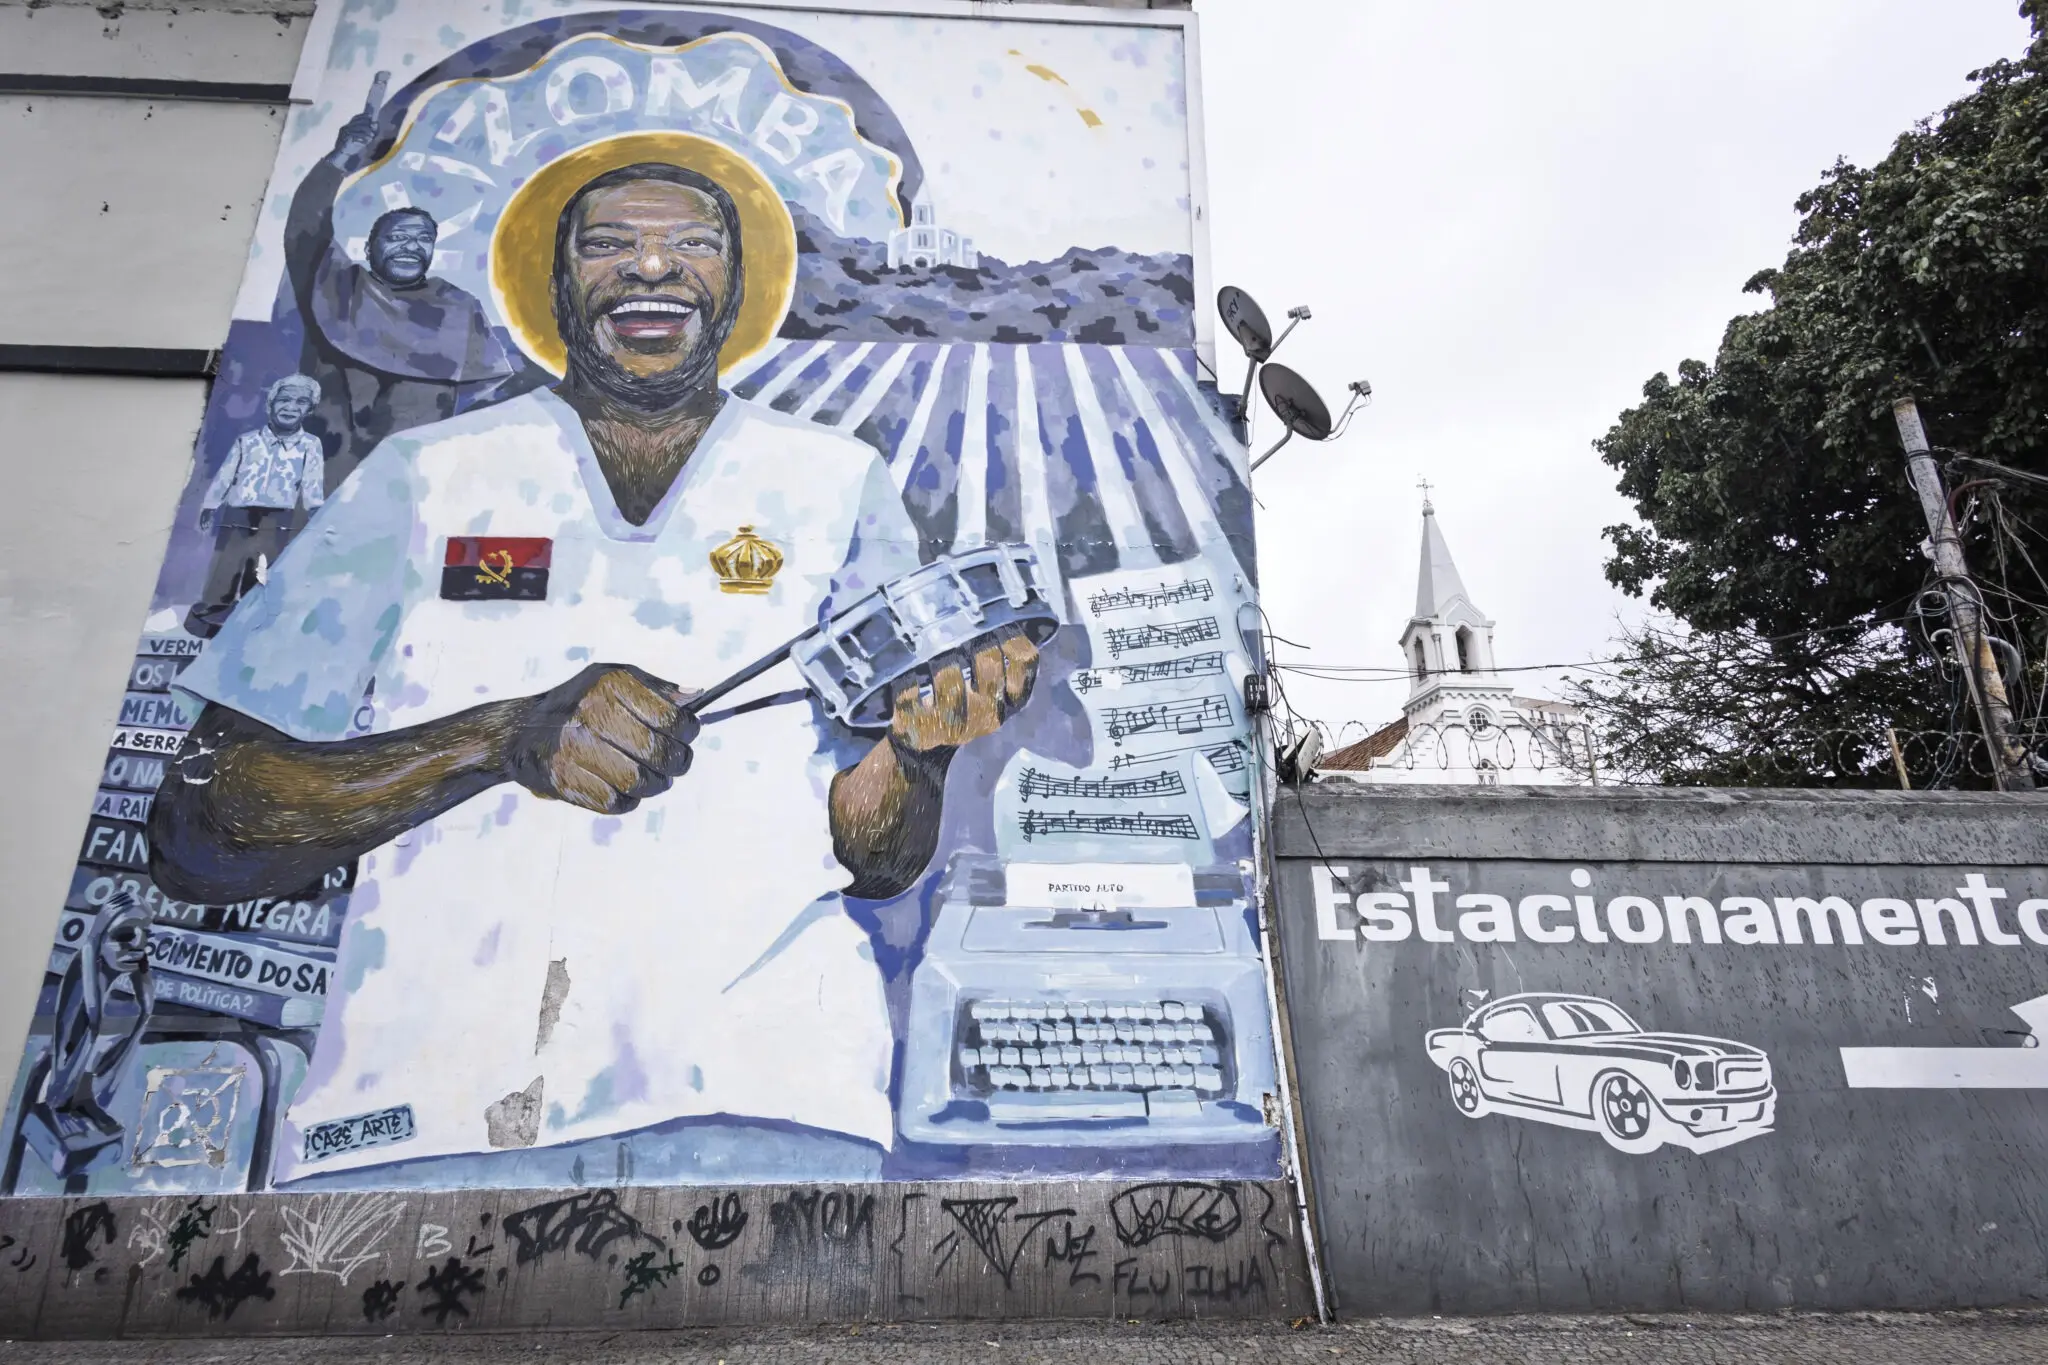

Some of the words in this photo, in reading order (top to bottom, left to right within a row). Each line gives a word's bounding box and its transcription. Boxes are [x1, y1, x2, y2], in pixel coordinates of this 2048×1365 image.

[135, 663, 164, 686] OS
[113, 731, 127, 747] A
[108, 755, 129, 783] O
[98, 797, 112, 814] A
[1047, 883, 1091, 893] PARTIDO
[1096, 883, 1124, 893] ALTO
[222, 897, 331, 937] NEGRA
[62, 918, 85, 942] O
[258, 959, 292, 988] DO
[292, 963, 334, 996] SA
[360, 1113, 404, 1142] ARTE
